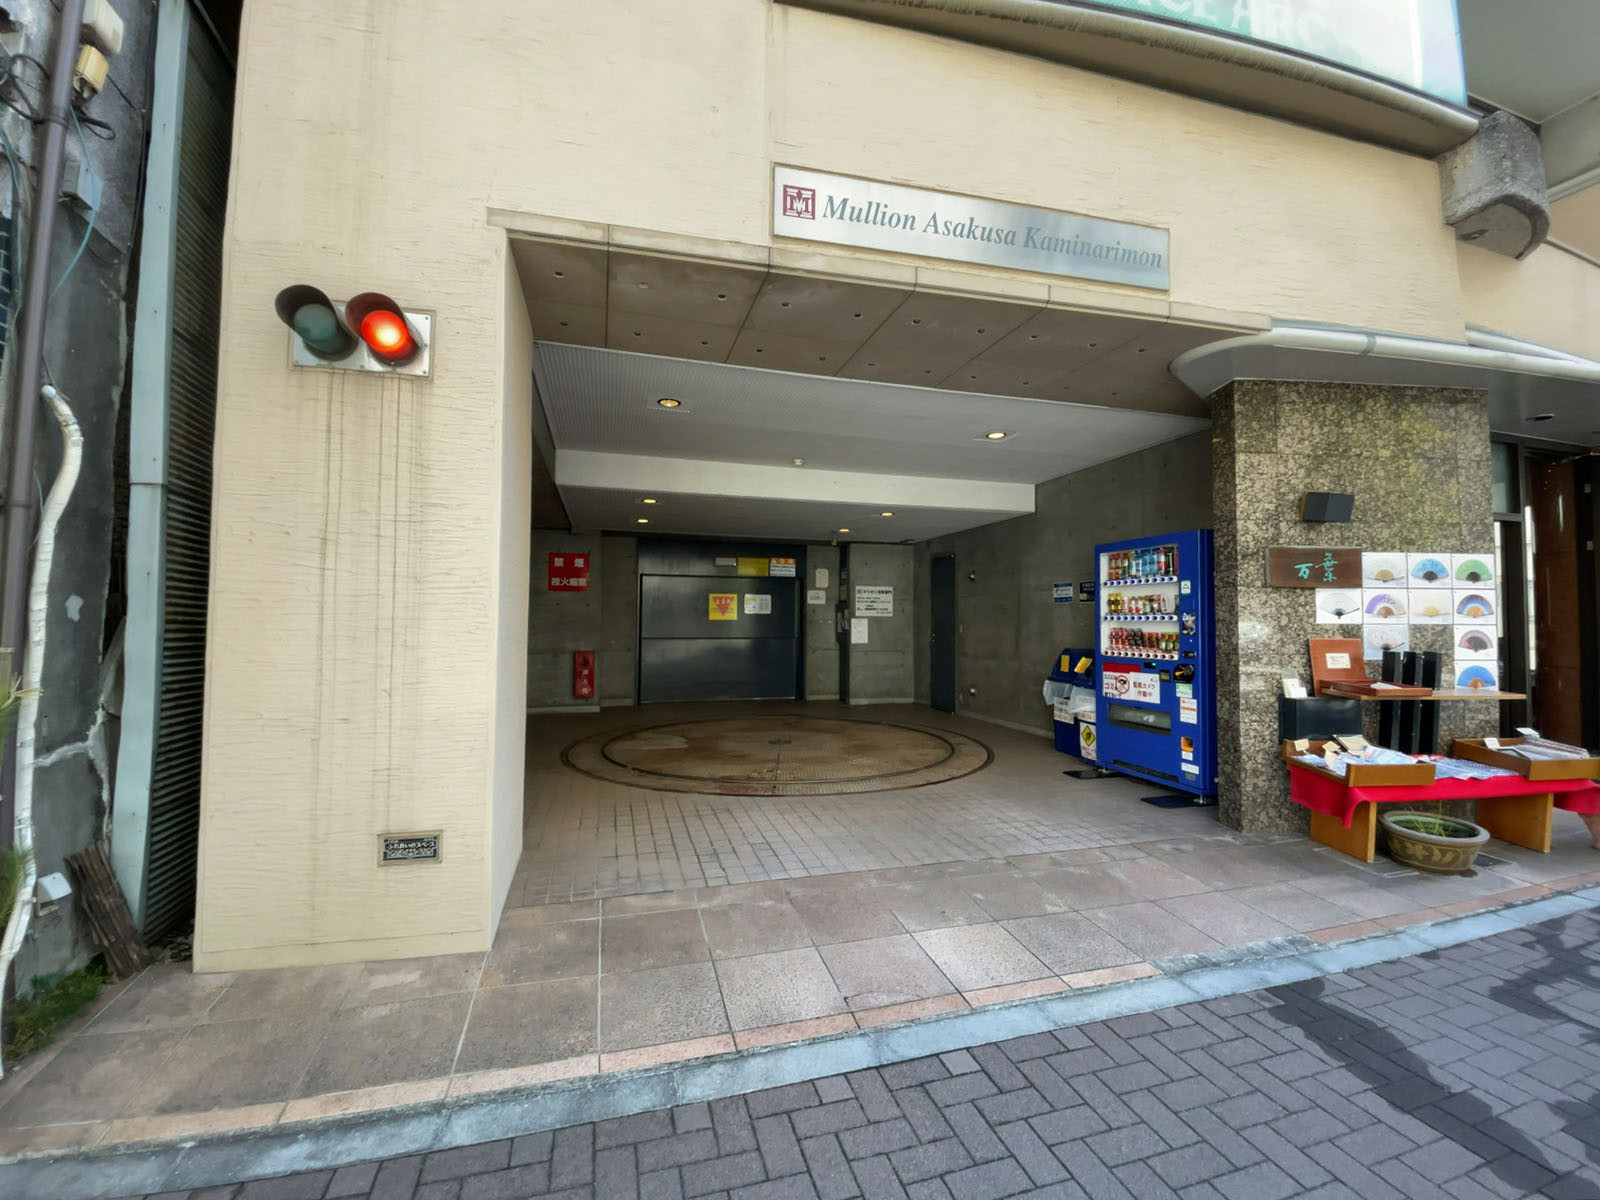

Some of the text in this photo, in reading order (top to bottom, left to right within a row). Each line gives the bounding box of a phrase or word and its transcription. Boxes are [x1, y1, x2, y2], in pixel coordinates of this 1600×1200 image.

[821, 194, 1163, 269] Mullion Asakusa Kaminarimon
